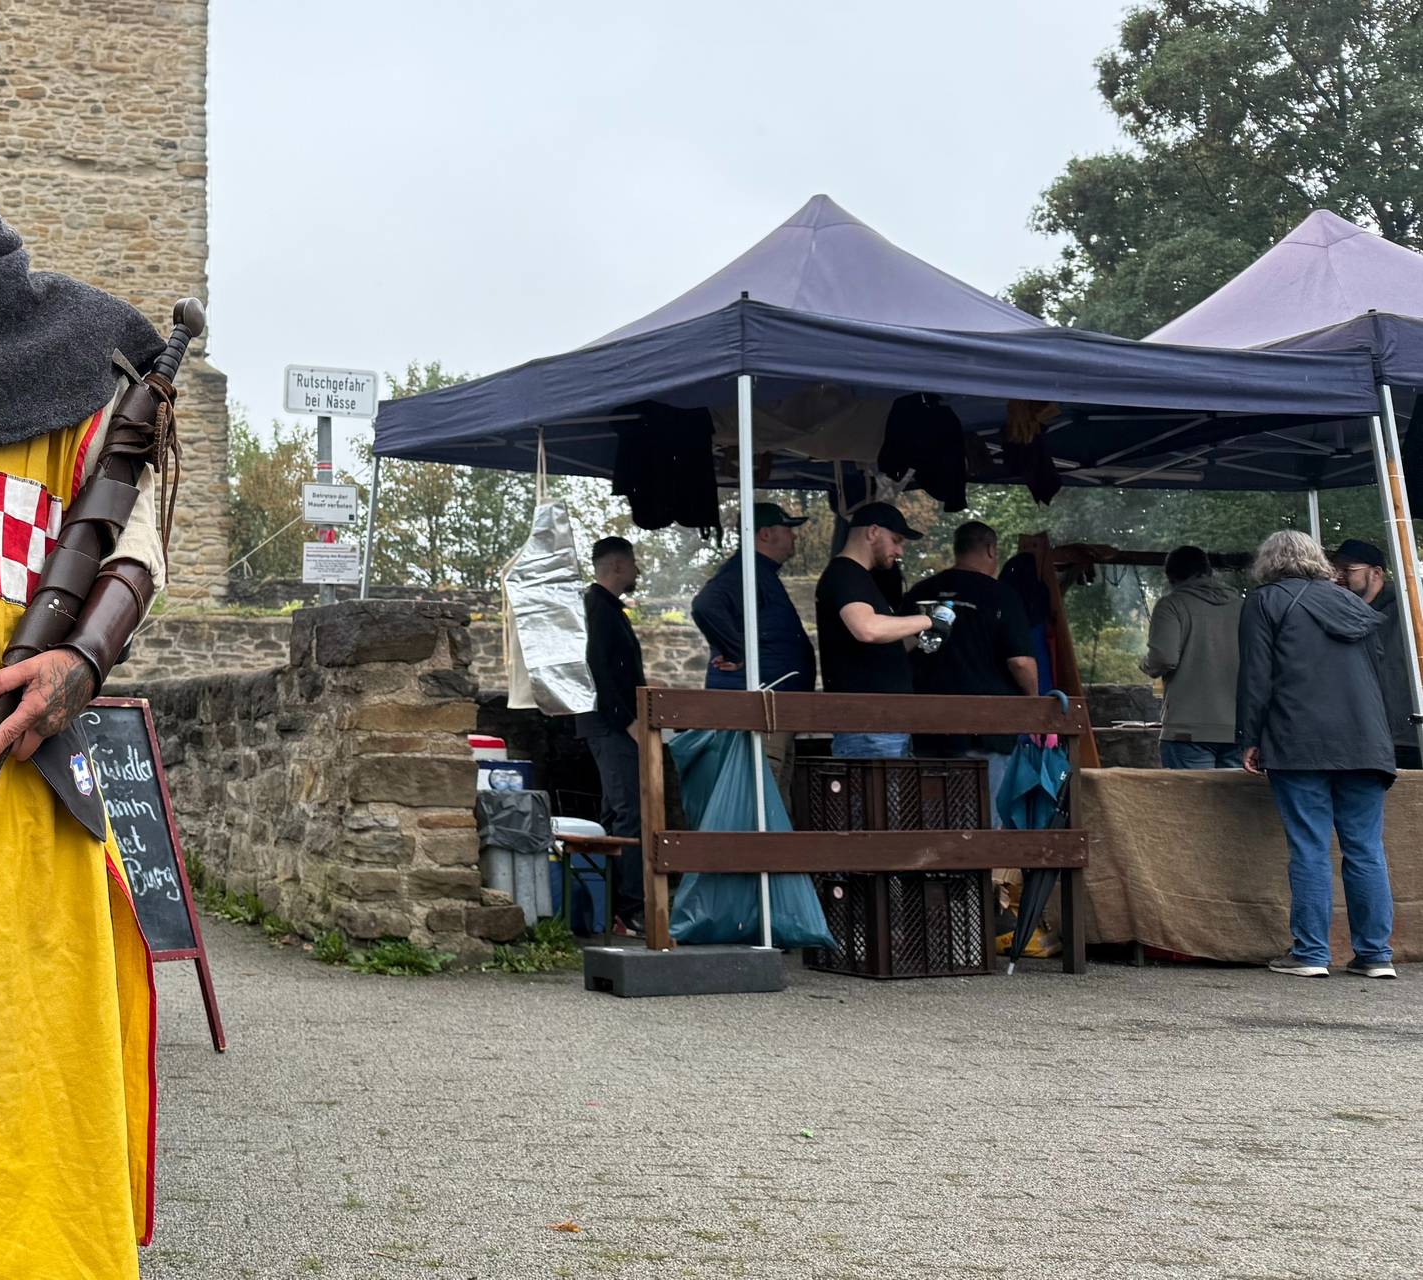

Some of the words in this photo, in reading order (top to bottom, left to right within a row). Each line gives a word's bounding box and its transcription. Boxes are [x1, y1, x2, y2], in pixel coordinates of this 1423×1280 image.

[305, 393, 320, 408] bei
[326, 394, 356, 410] Nässe
[123, 857, 181, 901] Burg
